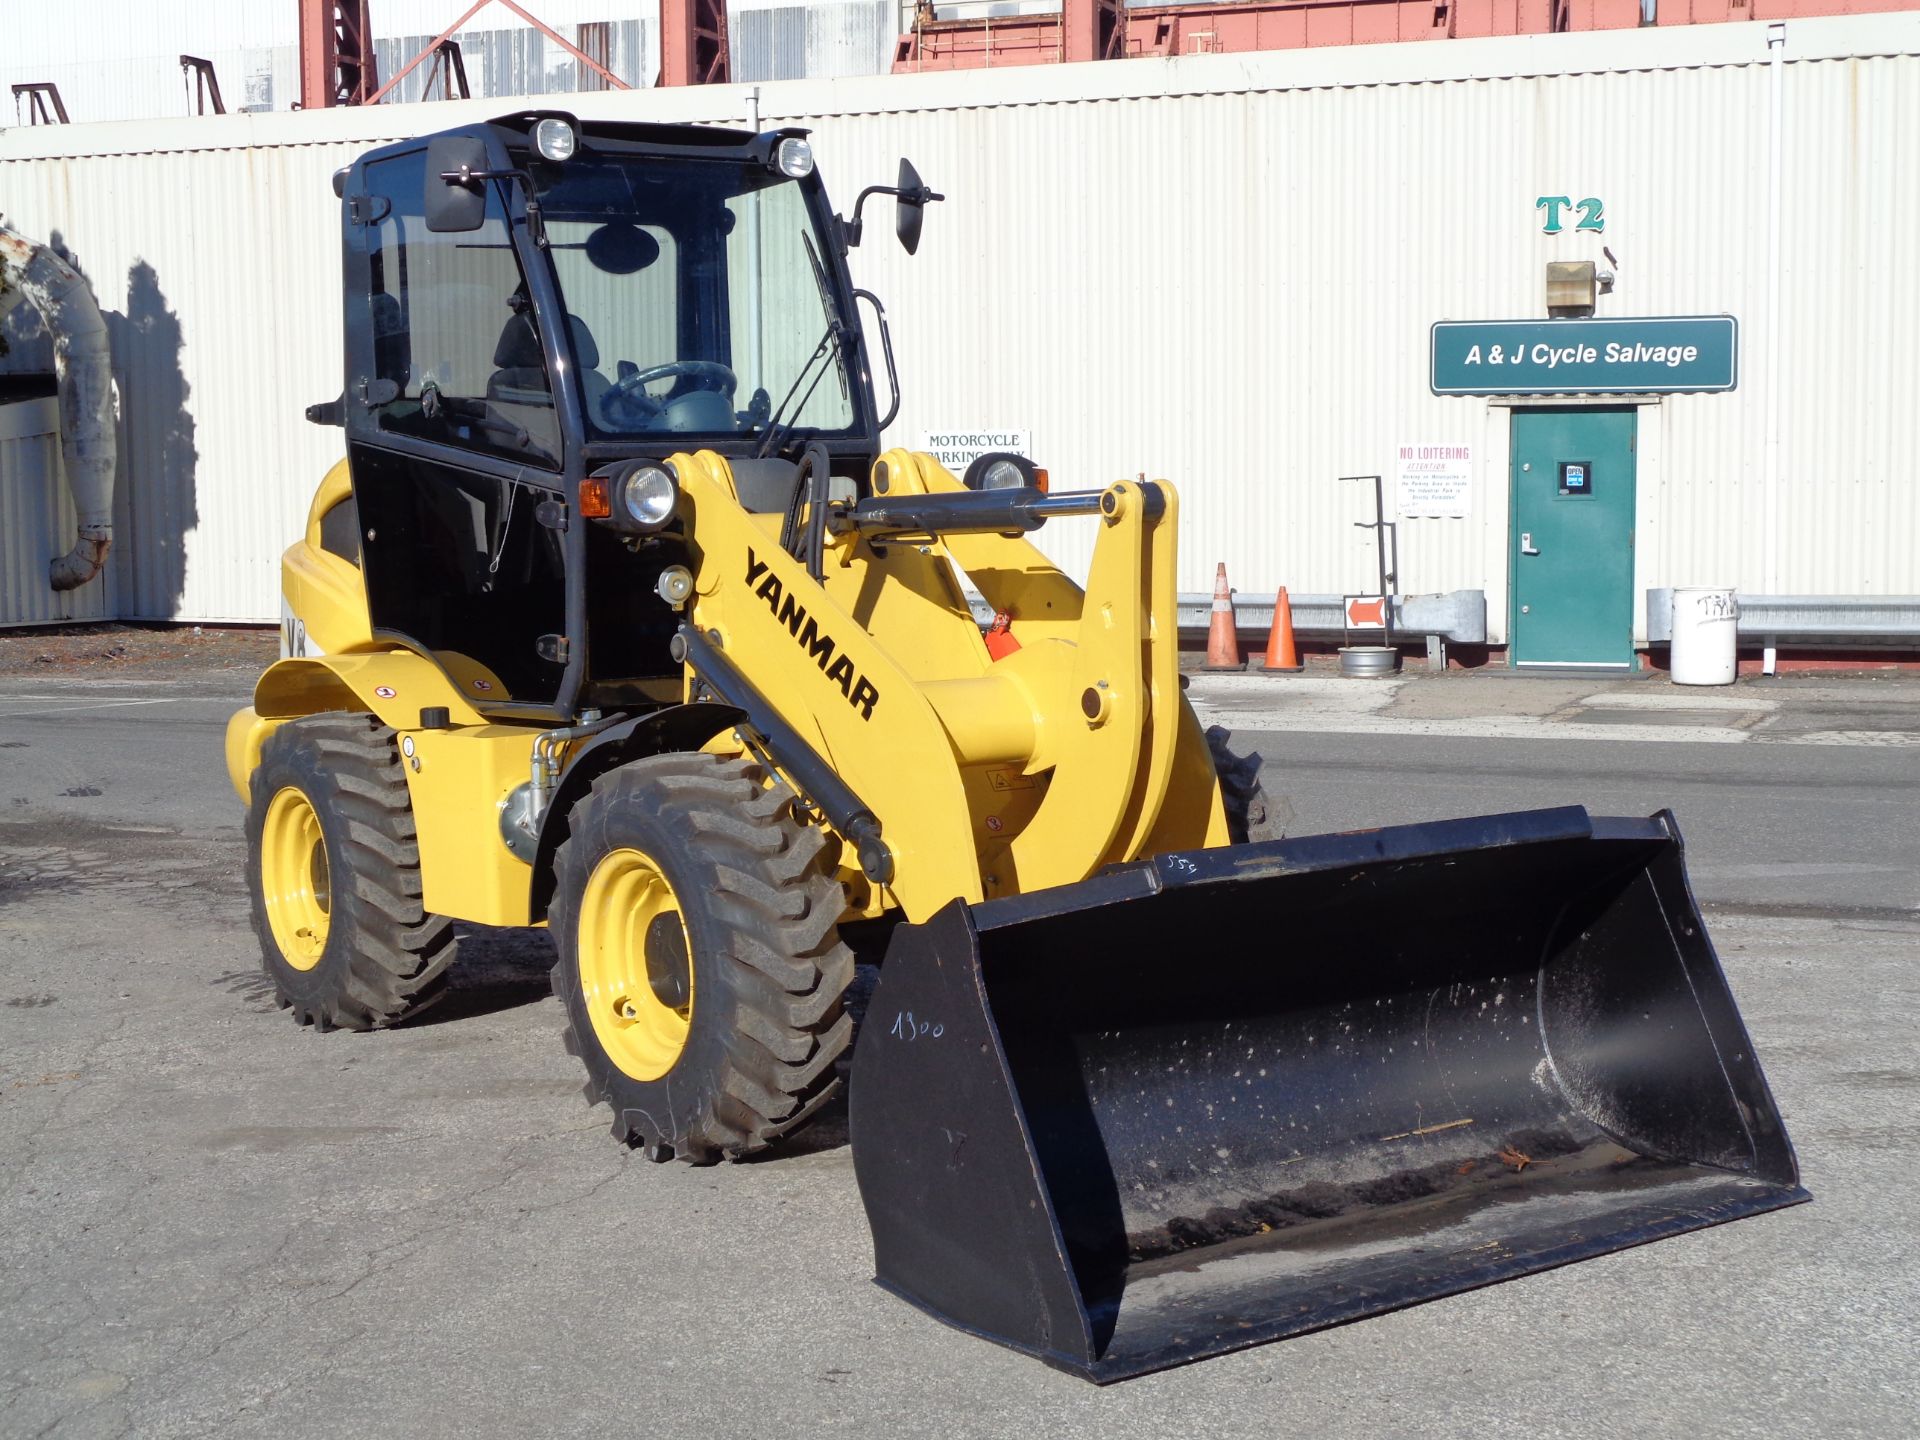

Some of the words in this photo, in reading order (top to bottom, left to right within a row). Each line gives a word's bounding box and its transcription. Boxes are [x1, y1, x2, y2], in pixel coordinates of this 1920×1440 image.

[1535, 195, 1606, 235] T2
[1465, 345, 1482, 365] A
[1488, 345, 1504, 364] &
[1511, 345, 1525, 365] J
[1531, 343, 1597, 368] Cycle
[1604, 342, 1698, 367] Salvage
[929, 434, 1020, 447] MOTORCYCLE
[1400, 447, 1413, 459] NO
[1418, 447, 1470, 459] LOITERING
[745, 545, 880, 722] YANMAR
